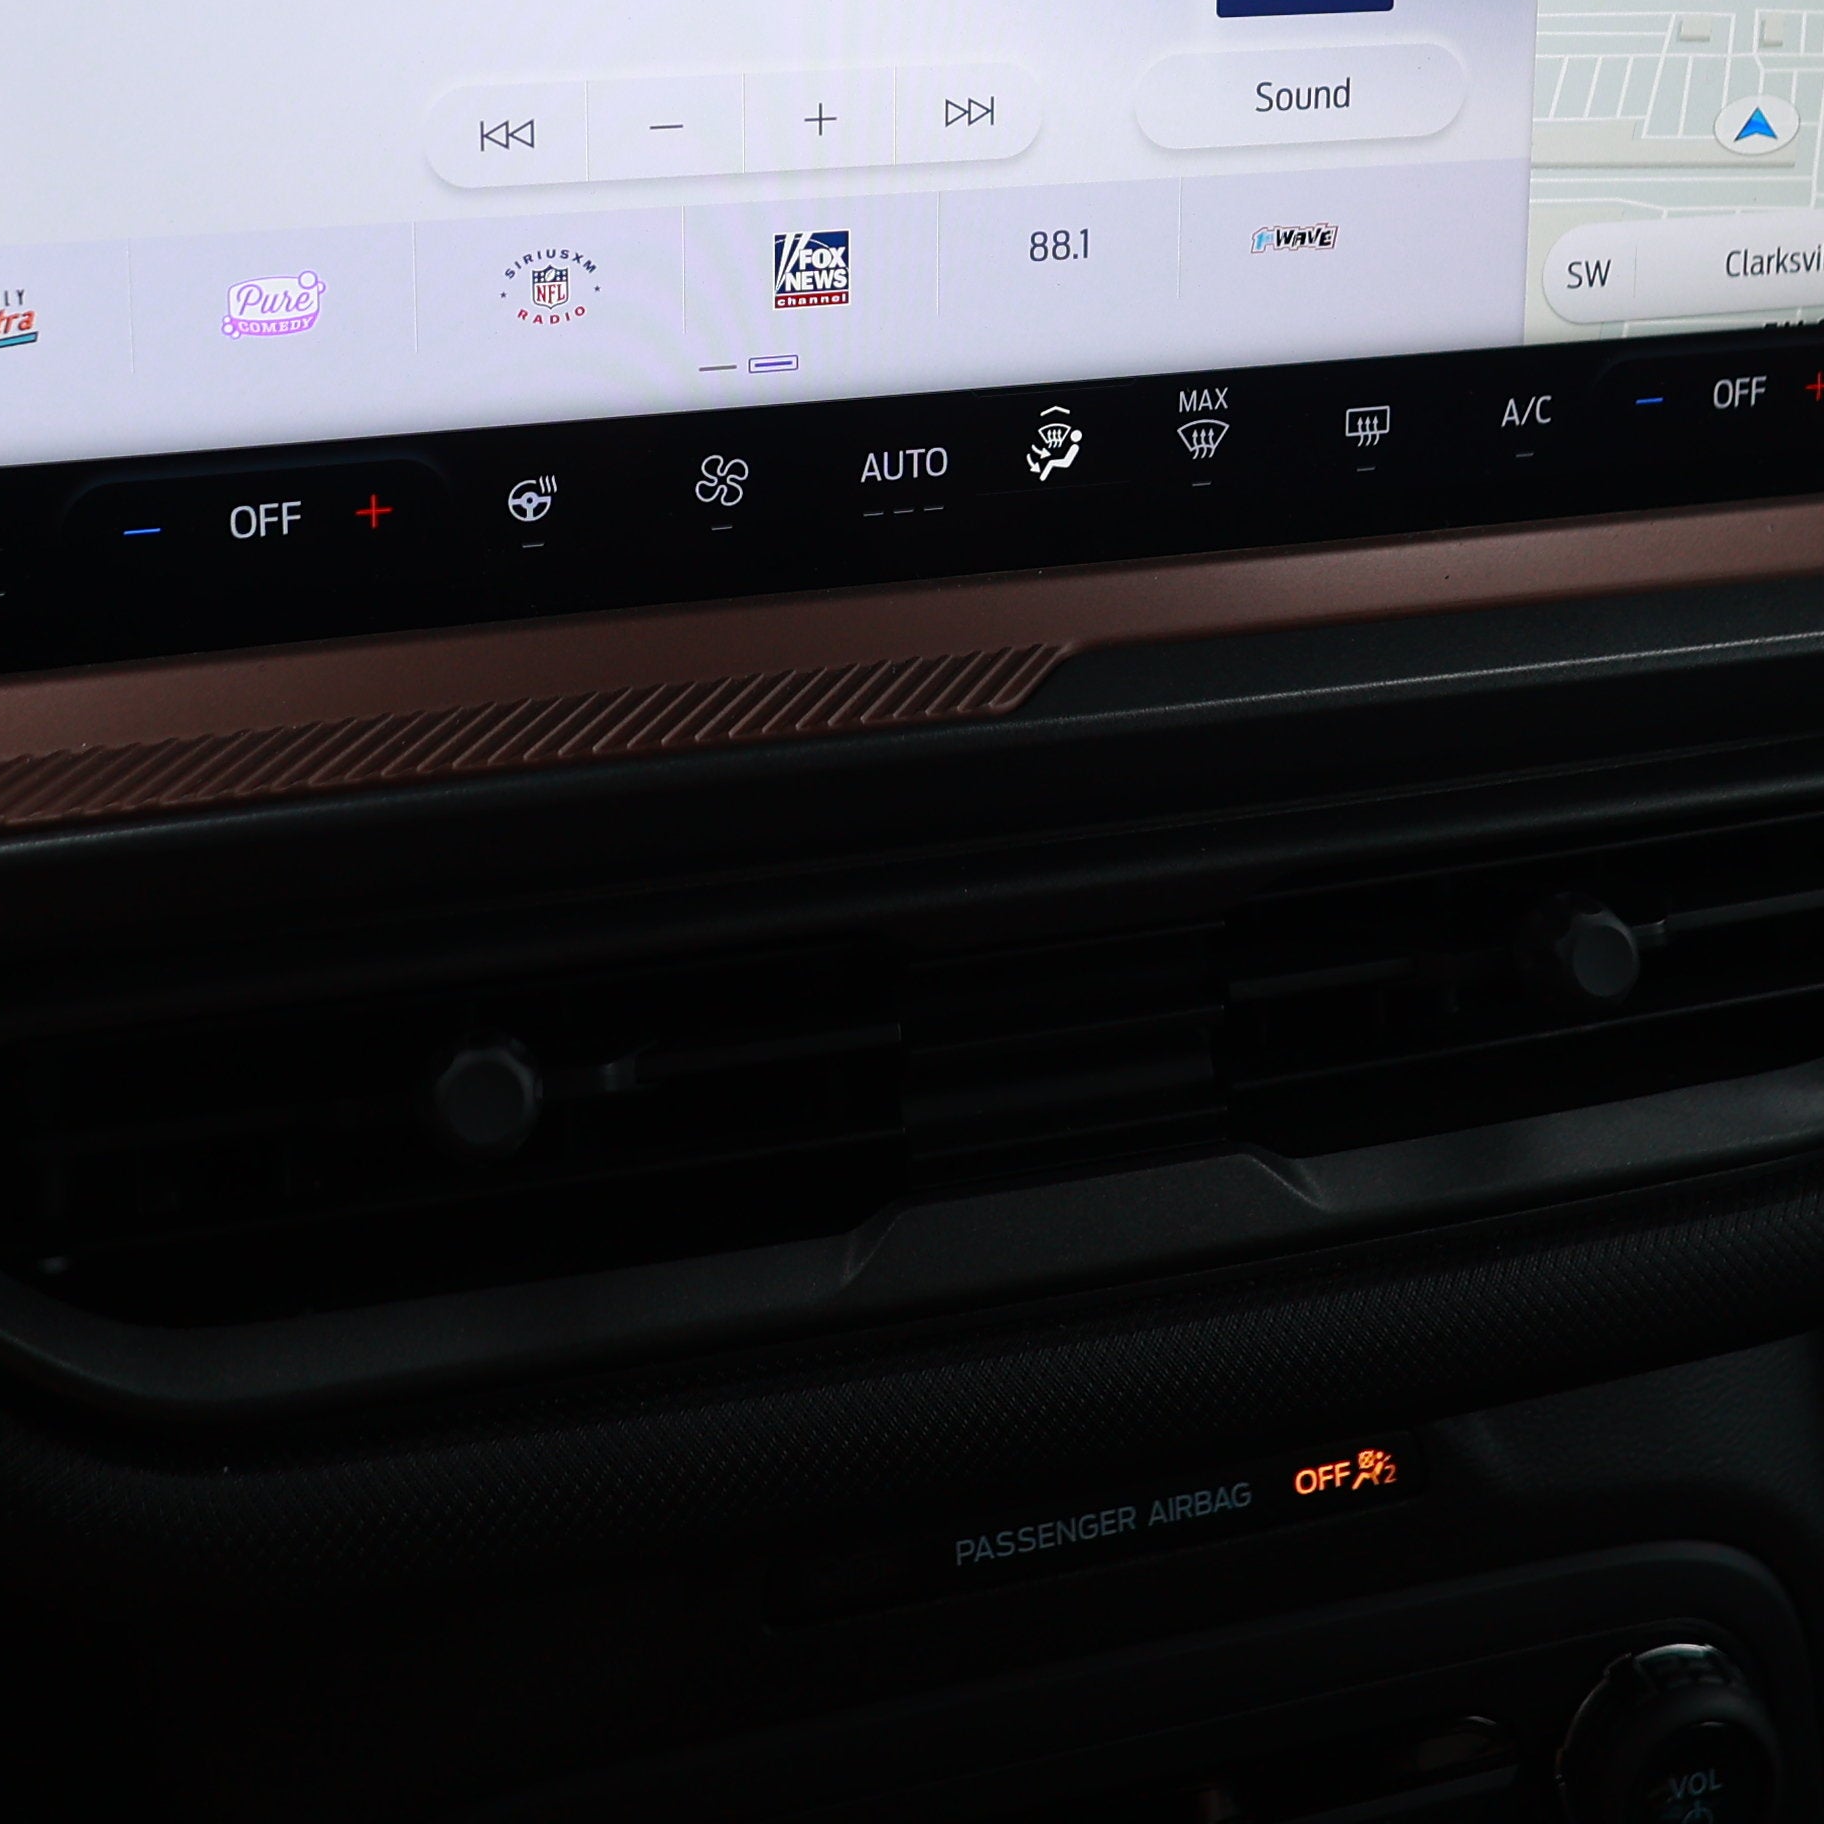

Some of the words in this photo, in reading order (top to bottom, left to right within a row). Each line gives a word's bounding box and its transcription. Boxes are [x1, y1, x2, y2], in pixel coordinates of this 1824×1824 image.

[1255, 76, 1351, 113] Sound
[1029, 228, 1089, 262] 88.1
[1276, 226, 1332, 248] WAVE
[504, 248, 597, 280] SIRIUSXM
[798, 246, 846, 270] FOX
[1567, 259, 1612, 289] SW
[536, 283, 566, 305] NFL
[784, 269, 848, 292] NEWS
[236, 283, 315, 316] Pure
[517, 306, 586, 325] RADIO
[237, 316, 314, 333] COMEDY
[1178, 387, 1229, 413] MAX
[1713, 375, 1767, 409] OFF
[1501, 395, 1552, 427] A/C
[860, 447, 948, 483] AUTO
[230, 500, 302, 539] OFF
[1294, 1461, 1352, 1495] OFF
[953, 1506, 1139, 1568] PASSENGER
[1147, 1480, 1255, 1528] AIRBAG
[1667, 1768, 1724, 1798] VOL
